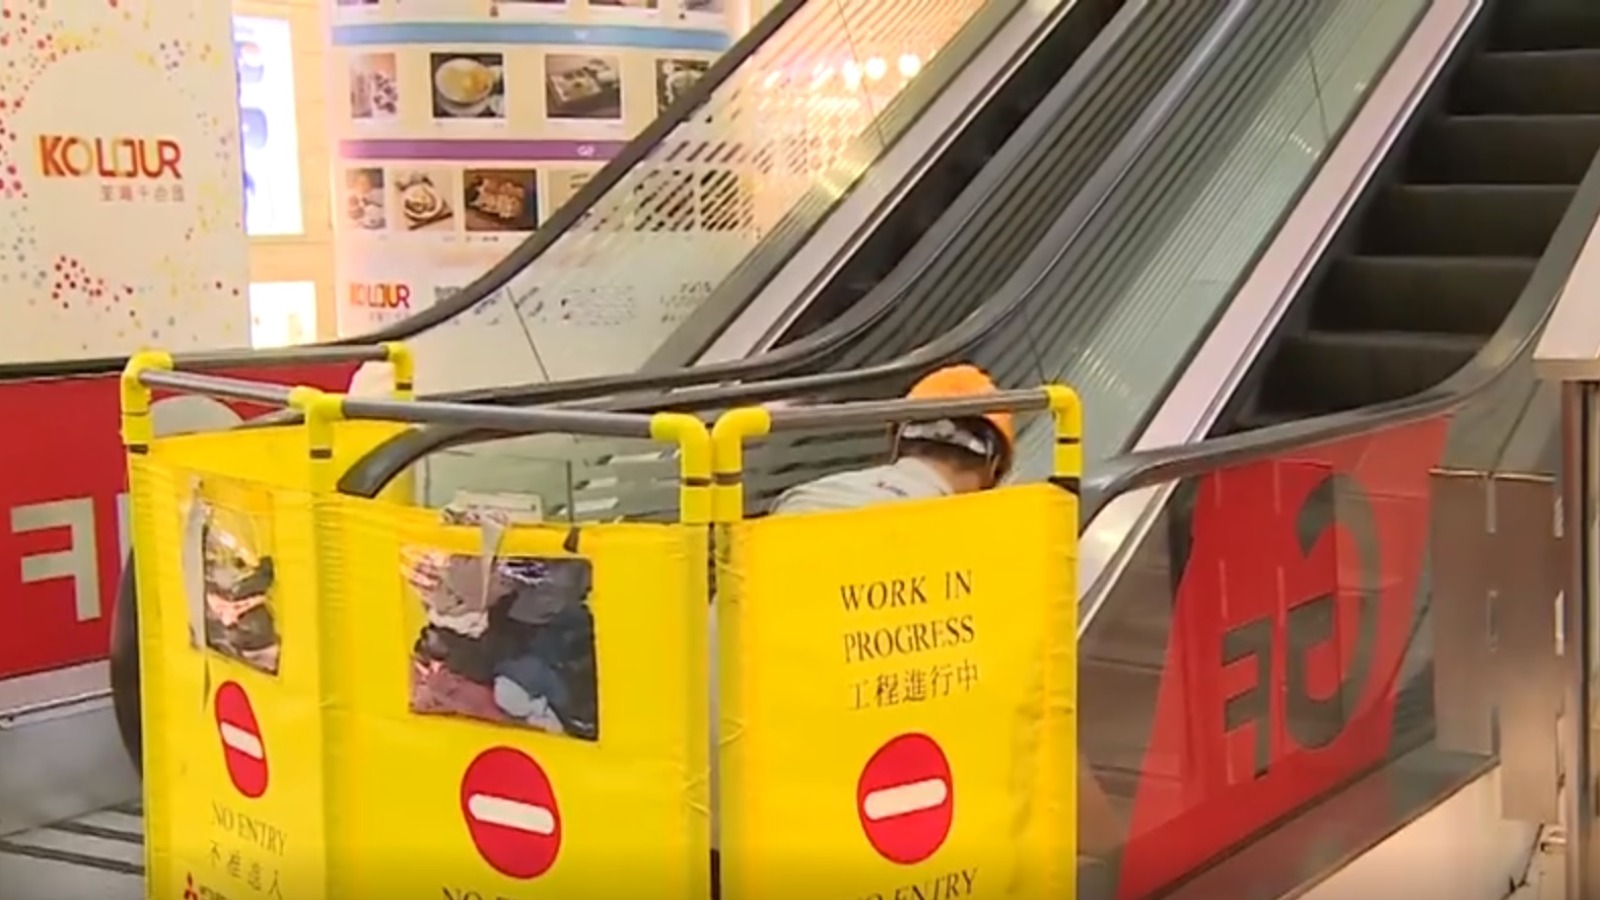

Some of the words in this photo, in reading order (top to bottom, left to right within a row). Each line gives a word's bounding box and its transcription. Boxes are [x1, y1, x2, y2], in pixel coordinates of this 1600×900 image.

[39, 134, 182, 179] KOLOUR
[840, 575, 928, 613] WORK
[944, 568, 973, 600] IN
[842, 614, 976, 665] PROGRESS
[846, 657, 979, 711] 工程進行中
[210, 799, 235, 831] NO
[237, 812, 288, 858] ENTRY
